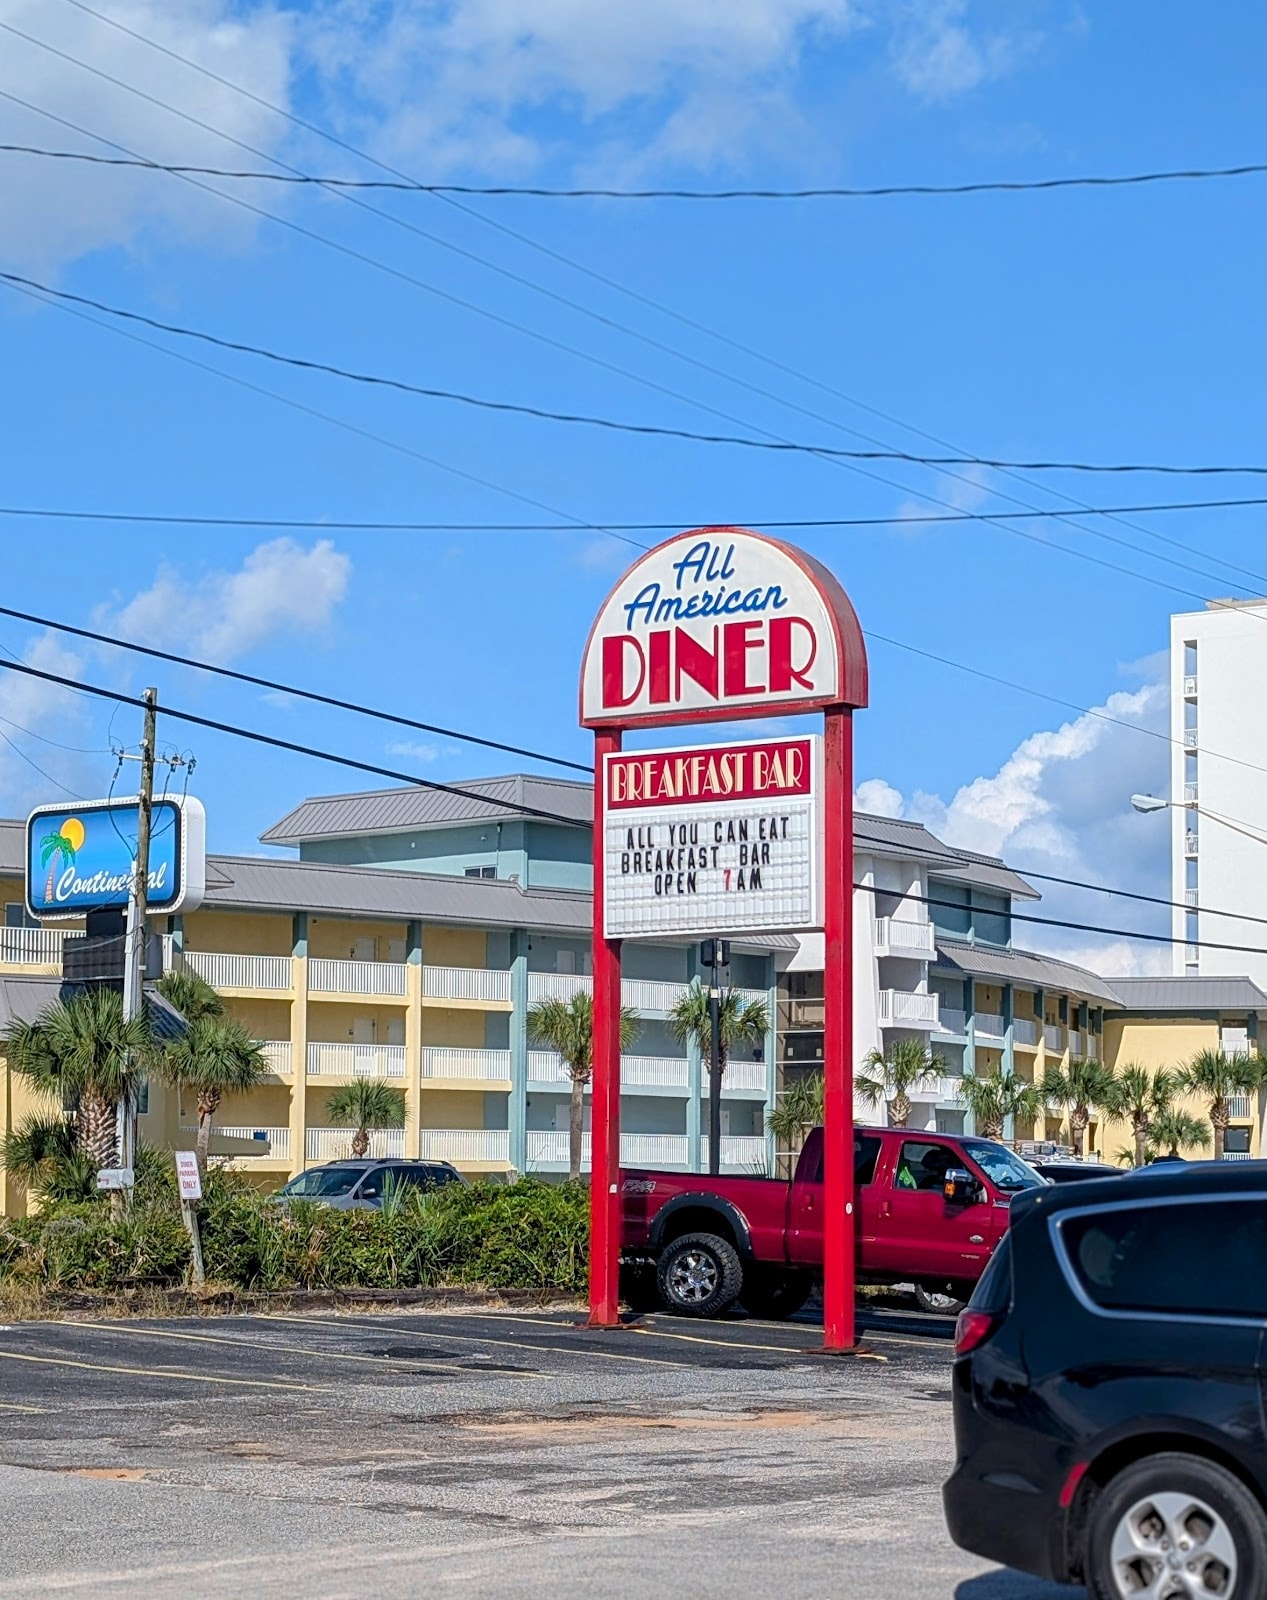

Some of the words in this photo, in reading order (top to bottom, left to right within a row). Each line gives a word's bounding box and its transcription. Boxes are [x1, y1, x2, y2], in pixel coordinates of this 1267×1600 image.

[672, 541, 735, 590] All
[623, 583, 788, 631] American
[602, 616, 817, 709] DINER
[611, 752, 748, 802] BREAKFAST
[753, 747, 804, 791] BAR
[626, 826, 655, 850] ALL
[668, 822, 699, 846] YOU
[714, 819, 749, 843] CAN
[758, 816, 790, 840] EAT
[621, 846, 720, 874] BREAKFAST
[739, 842, 771, 866] BAR
[654, 871, 697, 896] OPEN
[182, 1180, 196, 1189] ONLY
